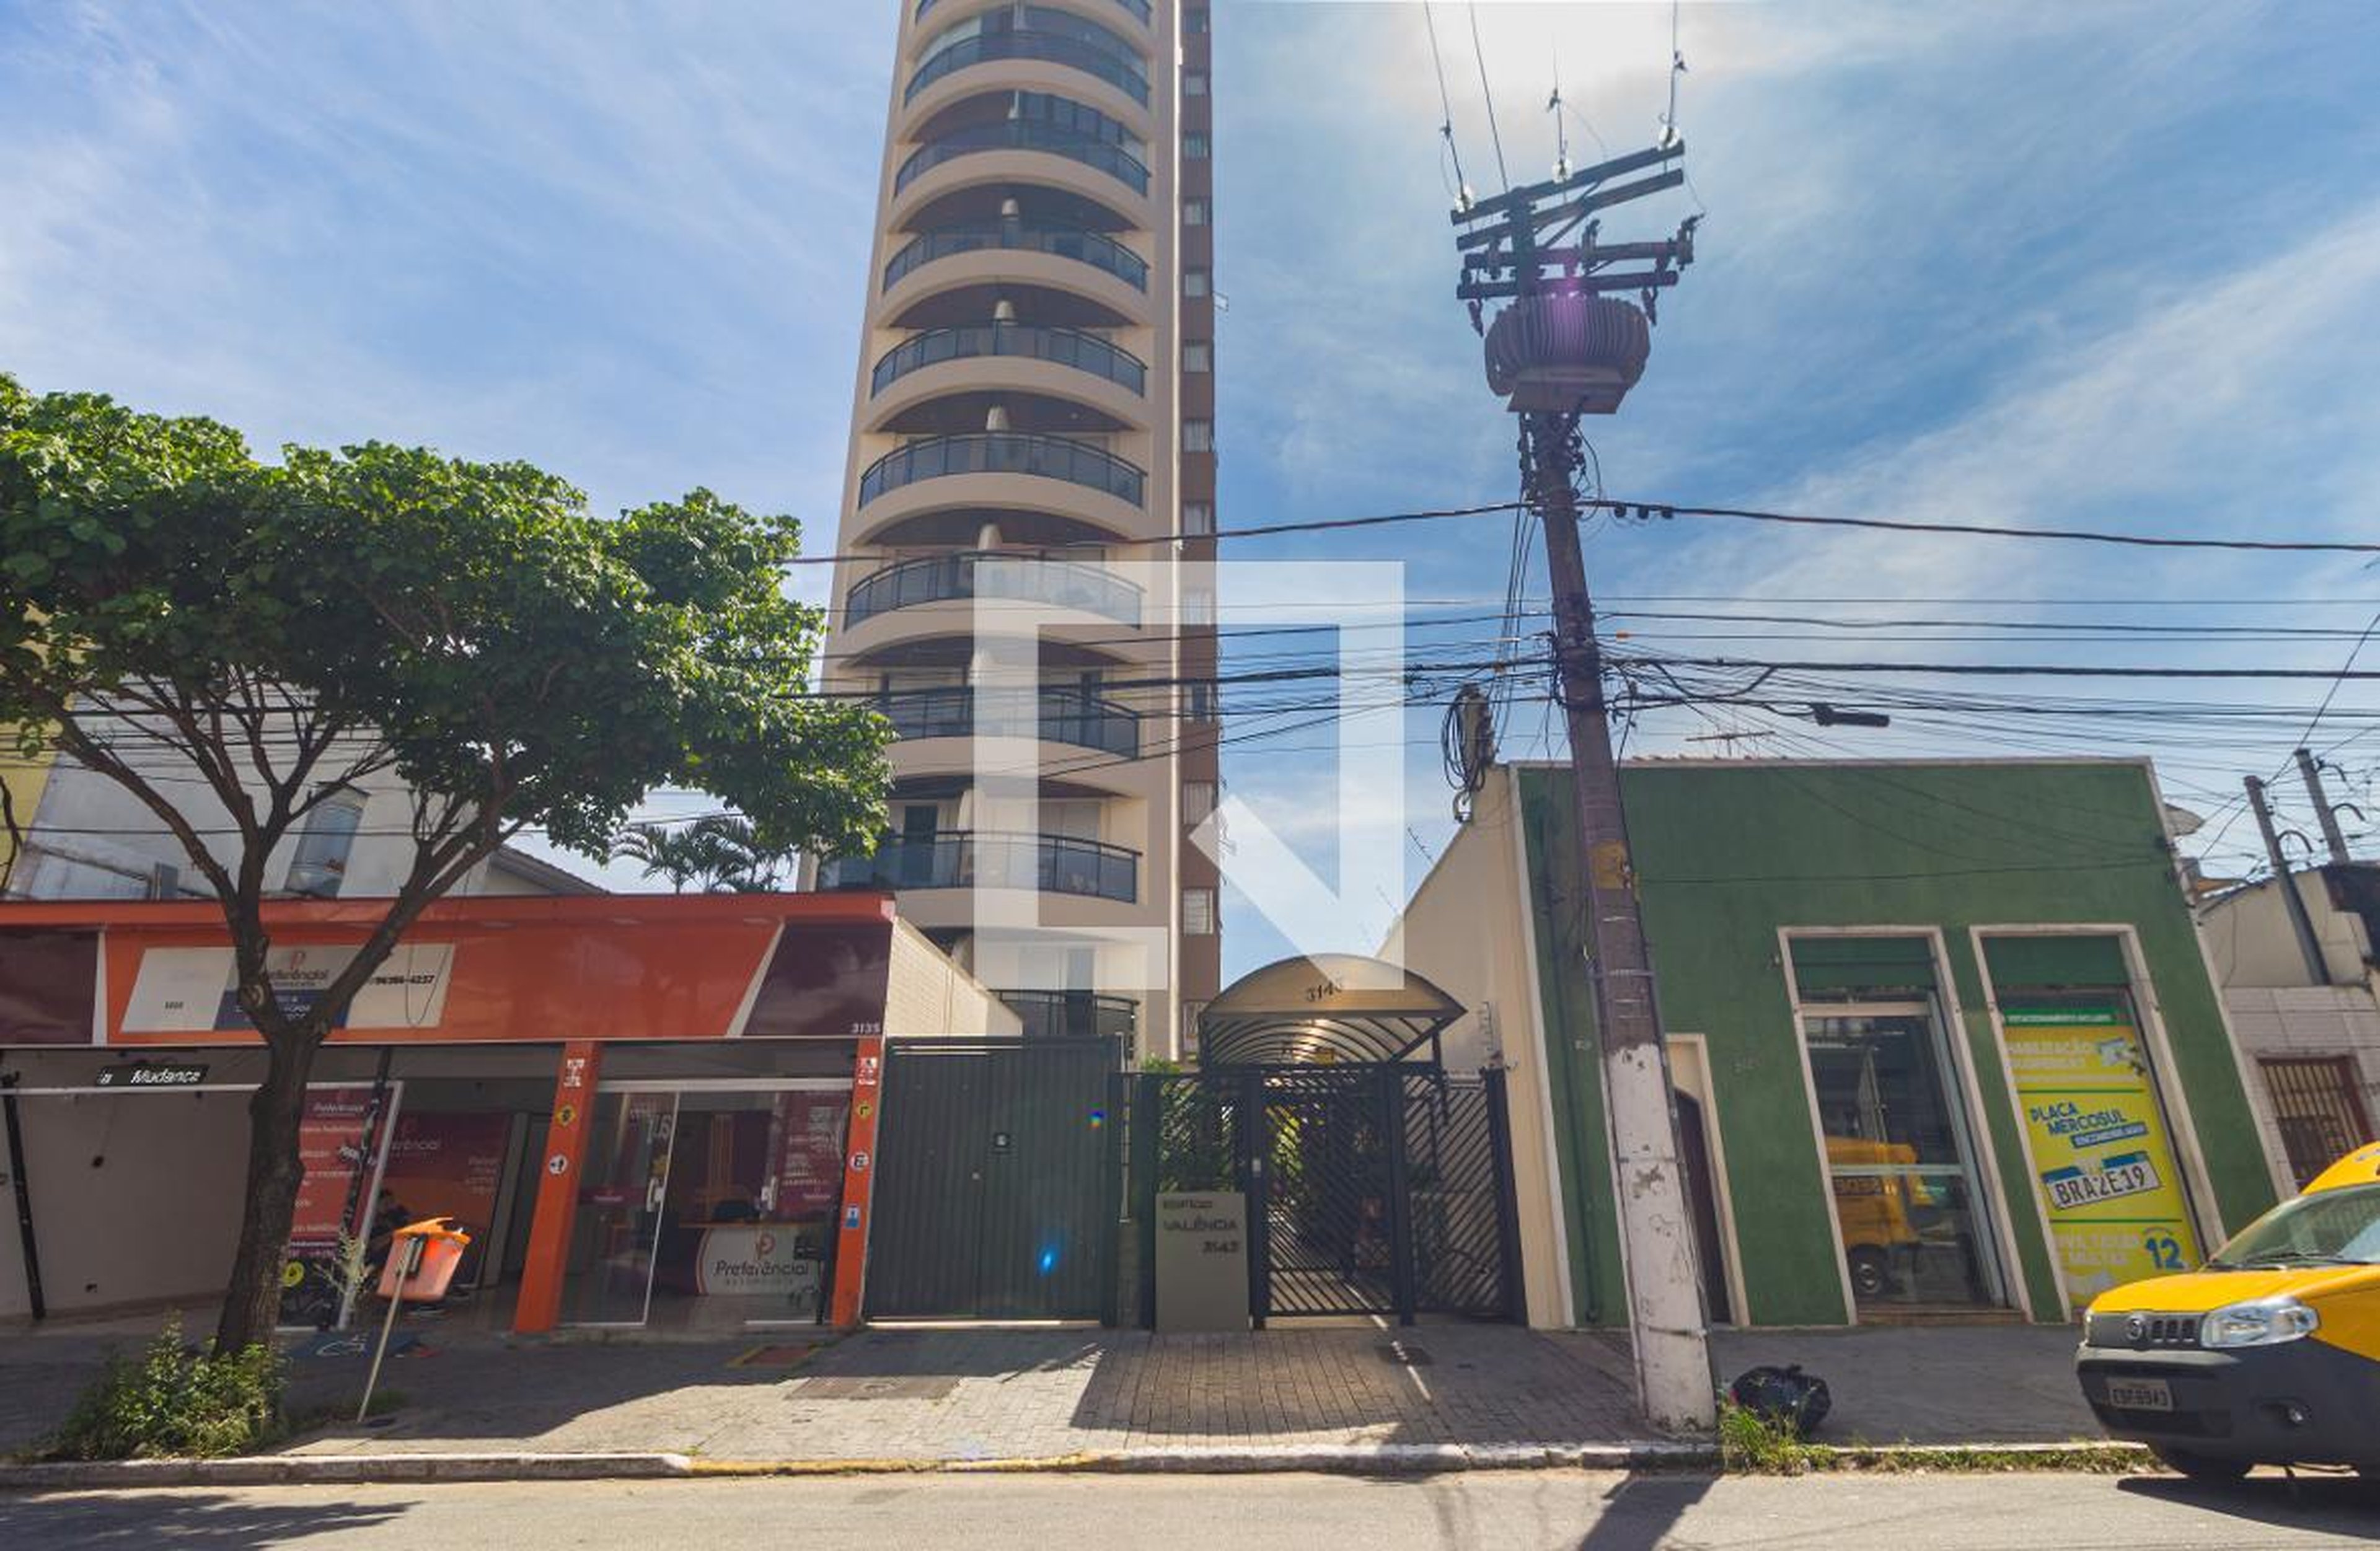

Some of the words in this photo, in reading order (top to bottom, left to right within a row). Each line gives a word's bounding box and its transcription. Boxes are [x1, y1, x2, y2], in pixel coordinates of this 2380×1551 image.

[2030, 1102, 2079, 1123] PLACA
[2048, 1109, 2127, 1135] MERCOSUL
[2055, 1165, 2145, 1205] BRA2E19
[2146, 1237, 2185, 1270] 12
